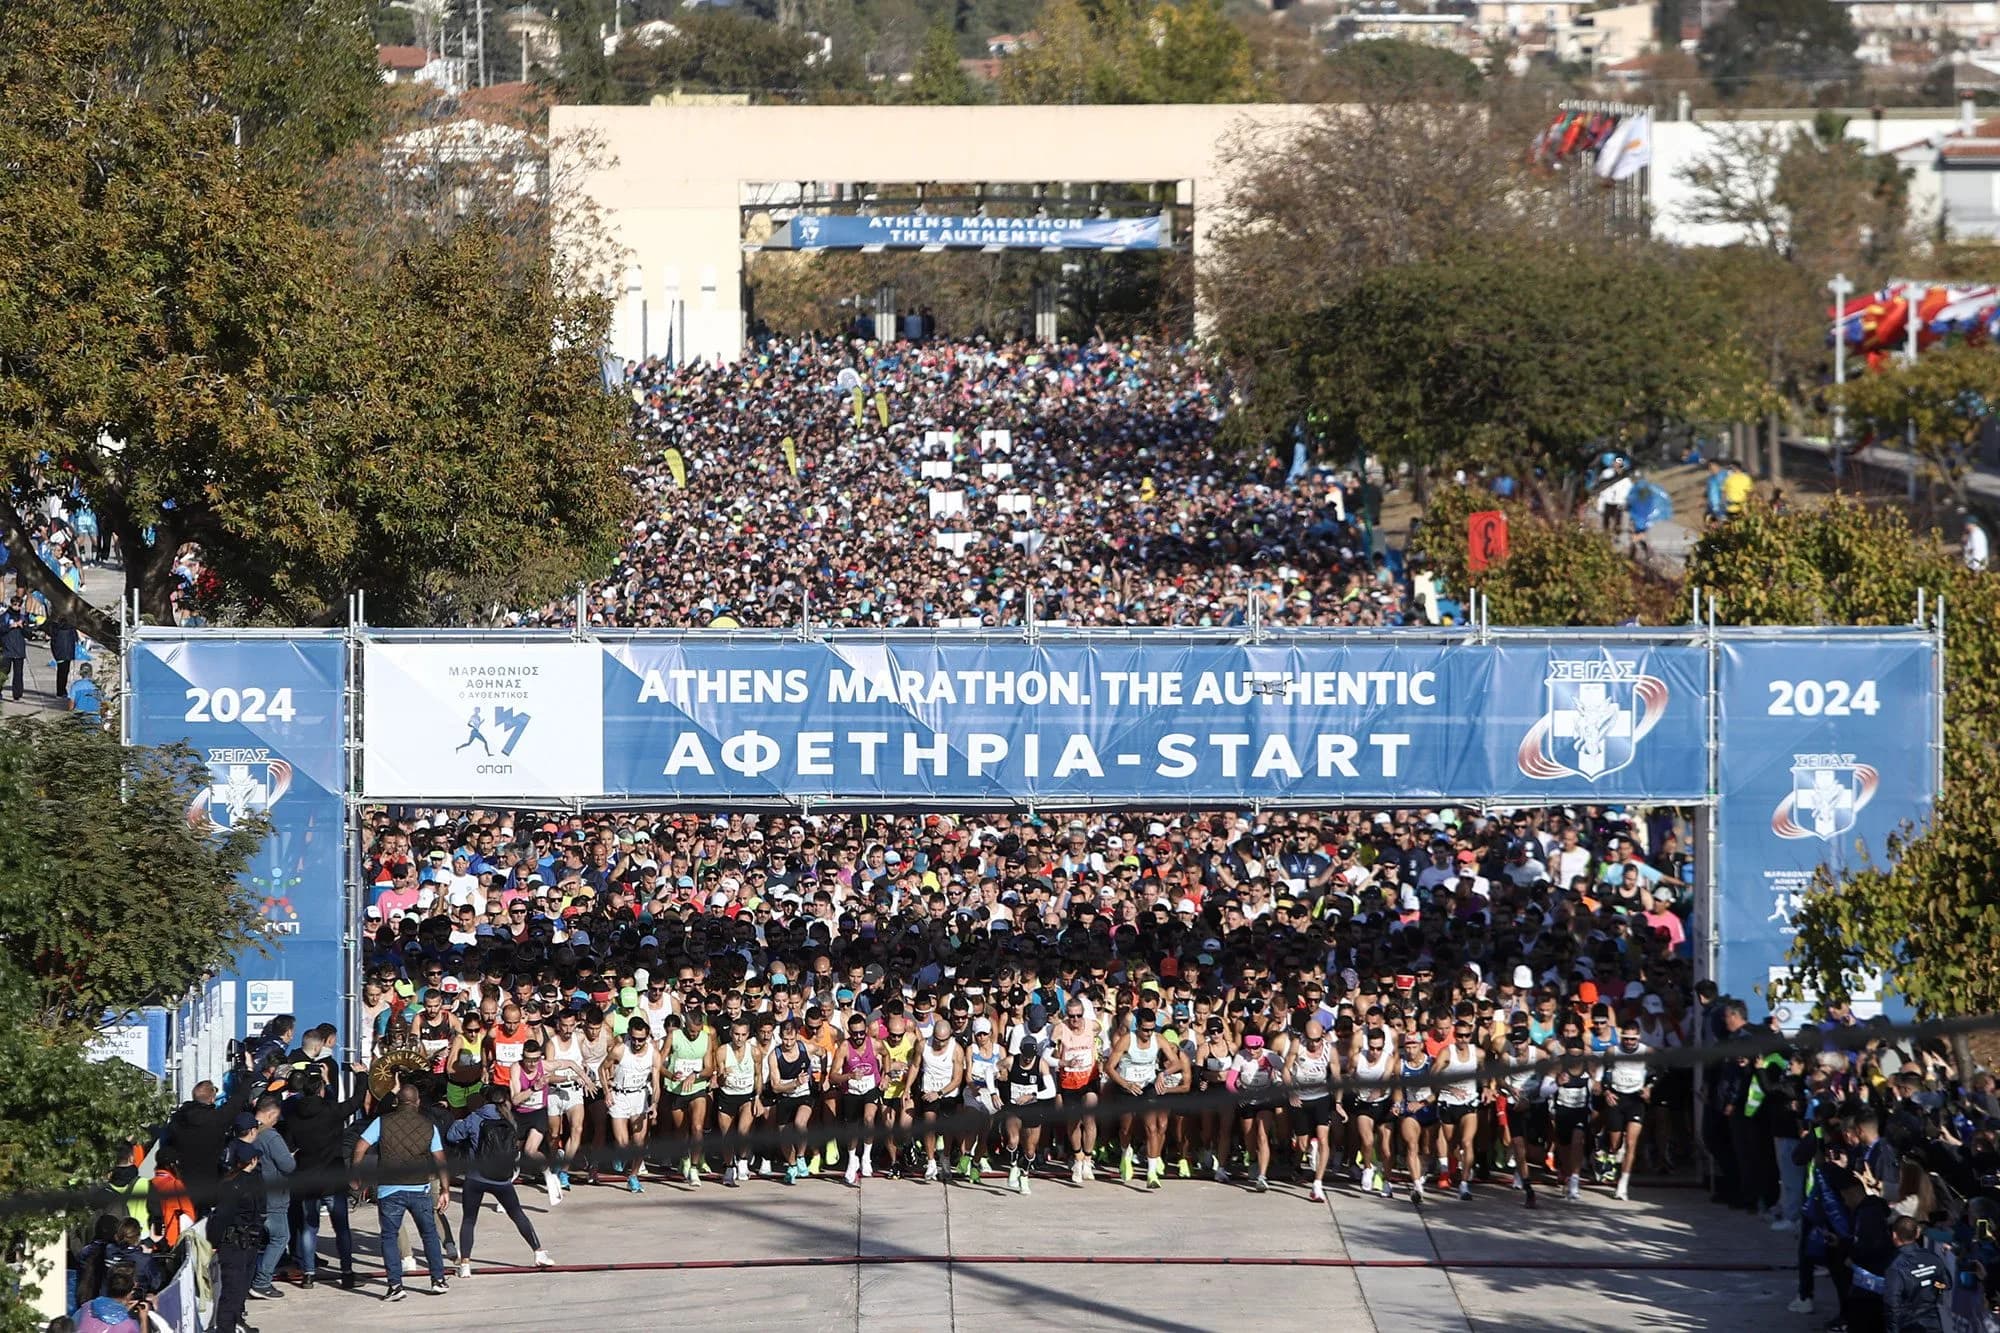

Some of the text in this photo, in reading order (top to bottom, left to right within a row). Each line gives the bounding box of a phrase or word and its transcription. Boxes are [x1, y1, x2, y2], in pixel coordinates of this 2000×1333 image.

[868, 216, 1084, 230] ATHENS MARATHON
[890, 229, 1062, 243] THE AUTHENTIC
[448, 666, 540, 676] ΜΑΡΑΘΩΝΙΟΣ
[1548, 660, 1637, 680] ΣΕΓΑΣ
[466, 679, 522, 689] ΑΘΗΝΑΣ
[637, 669, 1436, 706] ATHENS MARATHON. THE AUTHENTIC
[469, 691, 529, 699] ΑΥΘΕΝΤΙΚΟΣ
[1767, 680, 1880, 717] 2024
[184, 687, 296, 724] 2024
[208, 748, 271, 763] ΣΕΓΑΣ
[1793, 753, 1857, 768] ΣΕΓΑΣ
